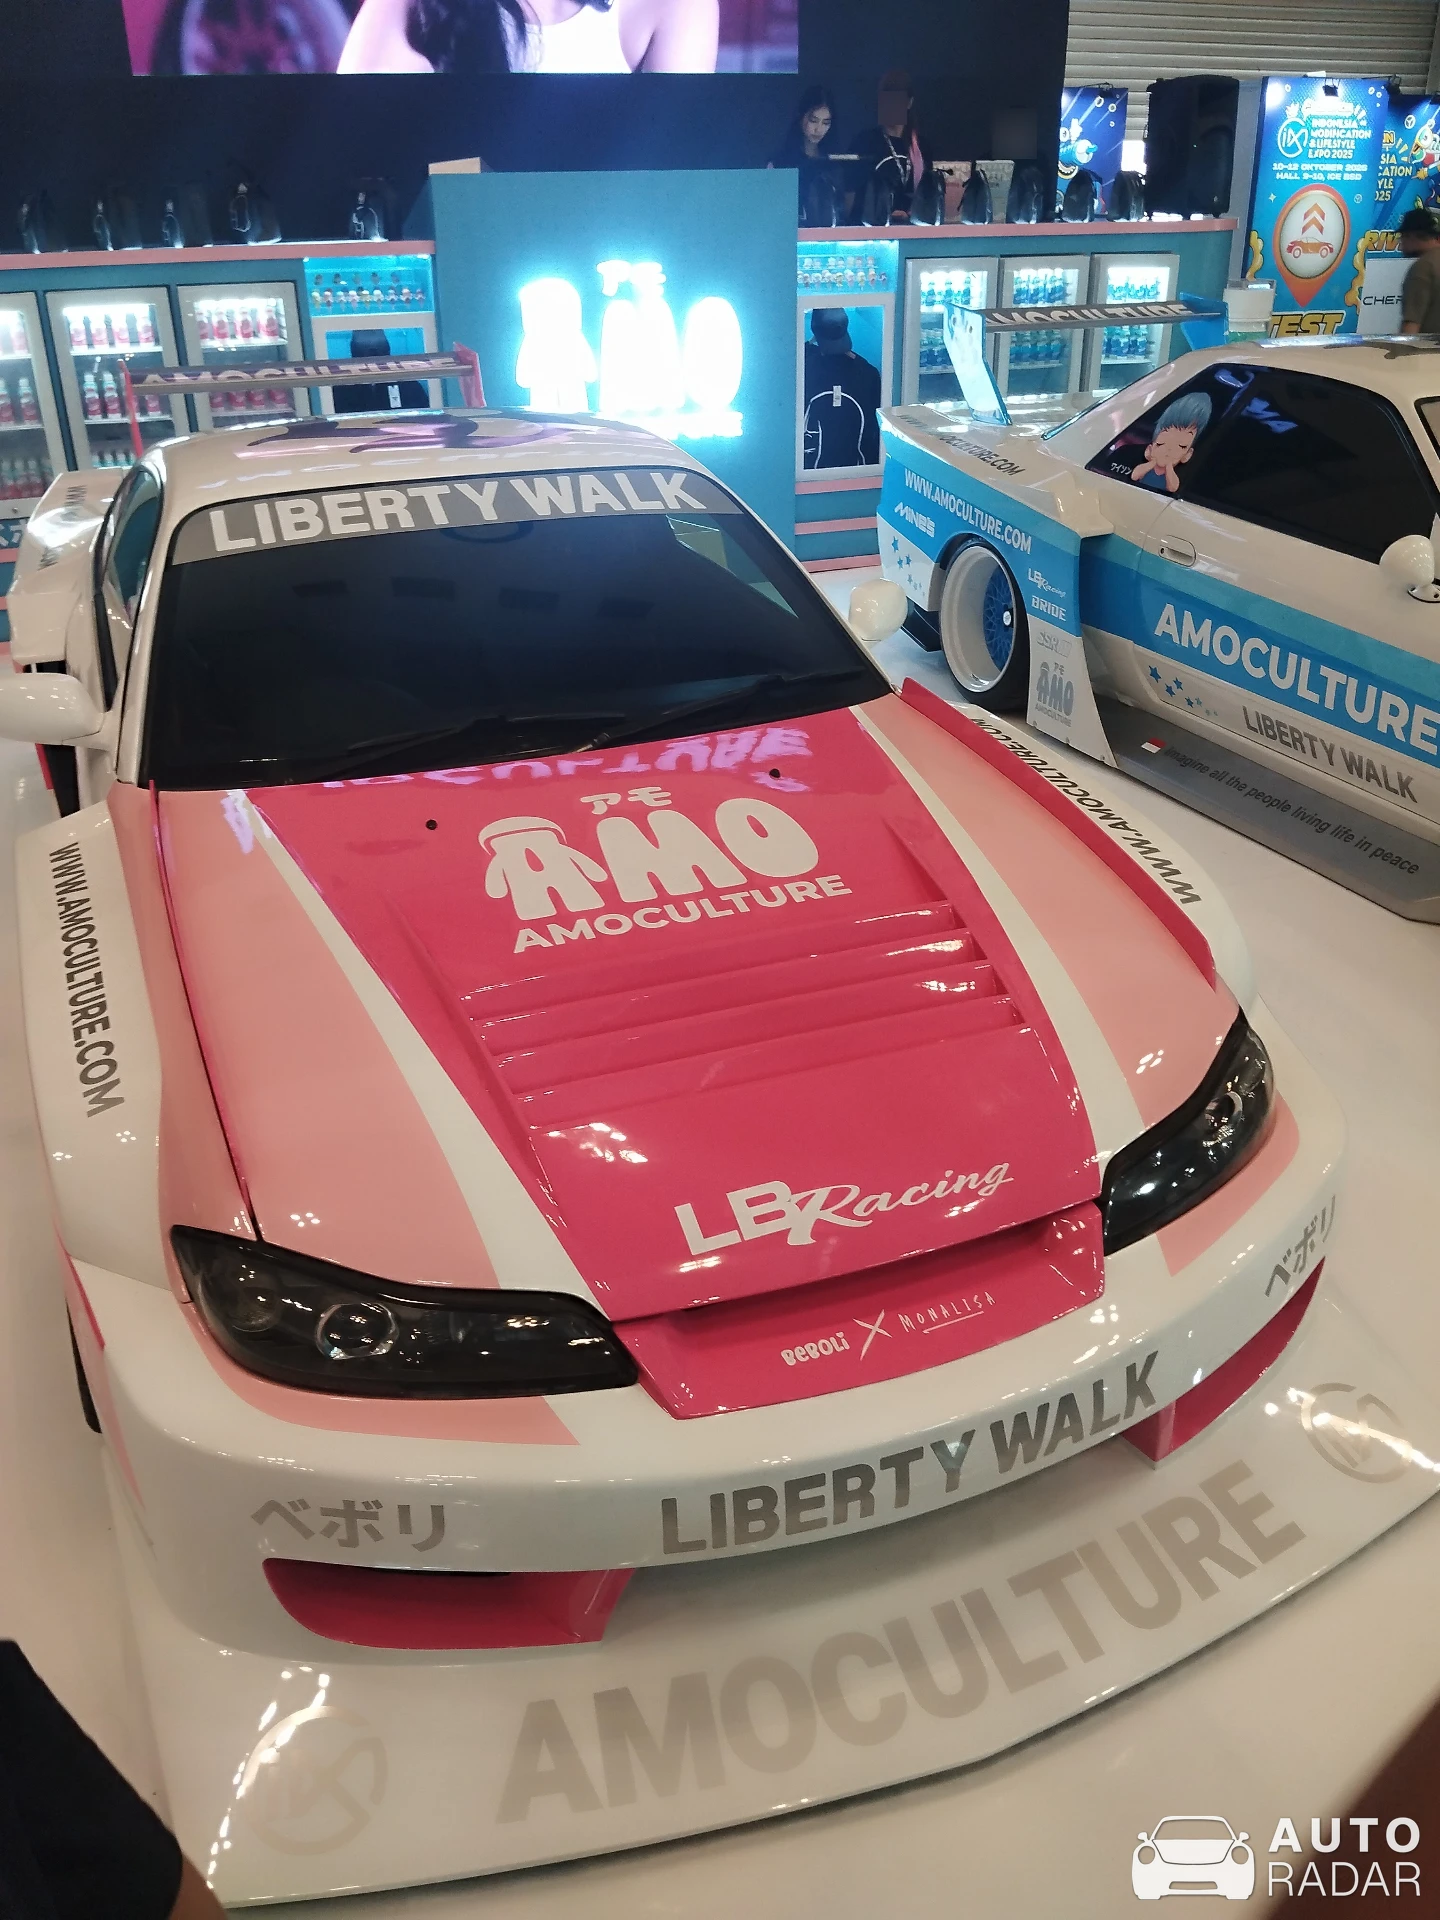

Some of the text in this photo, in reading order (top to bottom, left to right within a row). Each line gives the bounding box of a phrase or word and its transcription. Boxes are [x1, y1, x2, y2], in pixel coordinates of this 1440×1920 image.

[1275, 172, 1300, 180] HALL
[1331, 149, 1354, 159] 2025
[209, 472, 707, 552] LIBERTY WALK
[904, 467, 1032, 555] WWW.AMOCULTURE.COM
[1031, 594, 1067, 622] BRIDE
[1154, 603, 1440, 756] AMOCULTURE
[1242, 705, 1418, 803] LIBERTY WALK
[580, 786, 672, 815] アモ
[1209, 771, 1230, 782] all
[1225, 776, 1248, 792] the
[1243, 787, 1292, 813] people
[1291, 806, 1331, 834] living
[1330, 825, 1355, 843] life
[1354, 836, 1373, 852] in
[1369, 847, 1420, 874] peace
[478, 797, 819, 921] AMO
[513, 874, 853, 954] AMOCULTURE
[49, 842, 125, 1118] WWW.AMOCULTURE.COM
[661, 1428, 977, 1555] LIBERTY
[989, 1350, 1160, 1474] WALK
[251, 1498, 445, 1552] ベボリ
[496, 1459, 1306, 1824] AMOCULTURE
